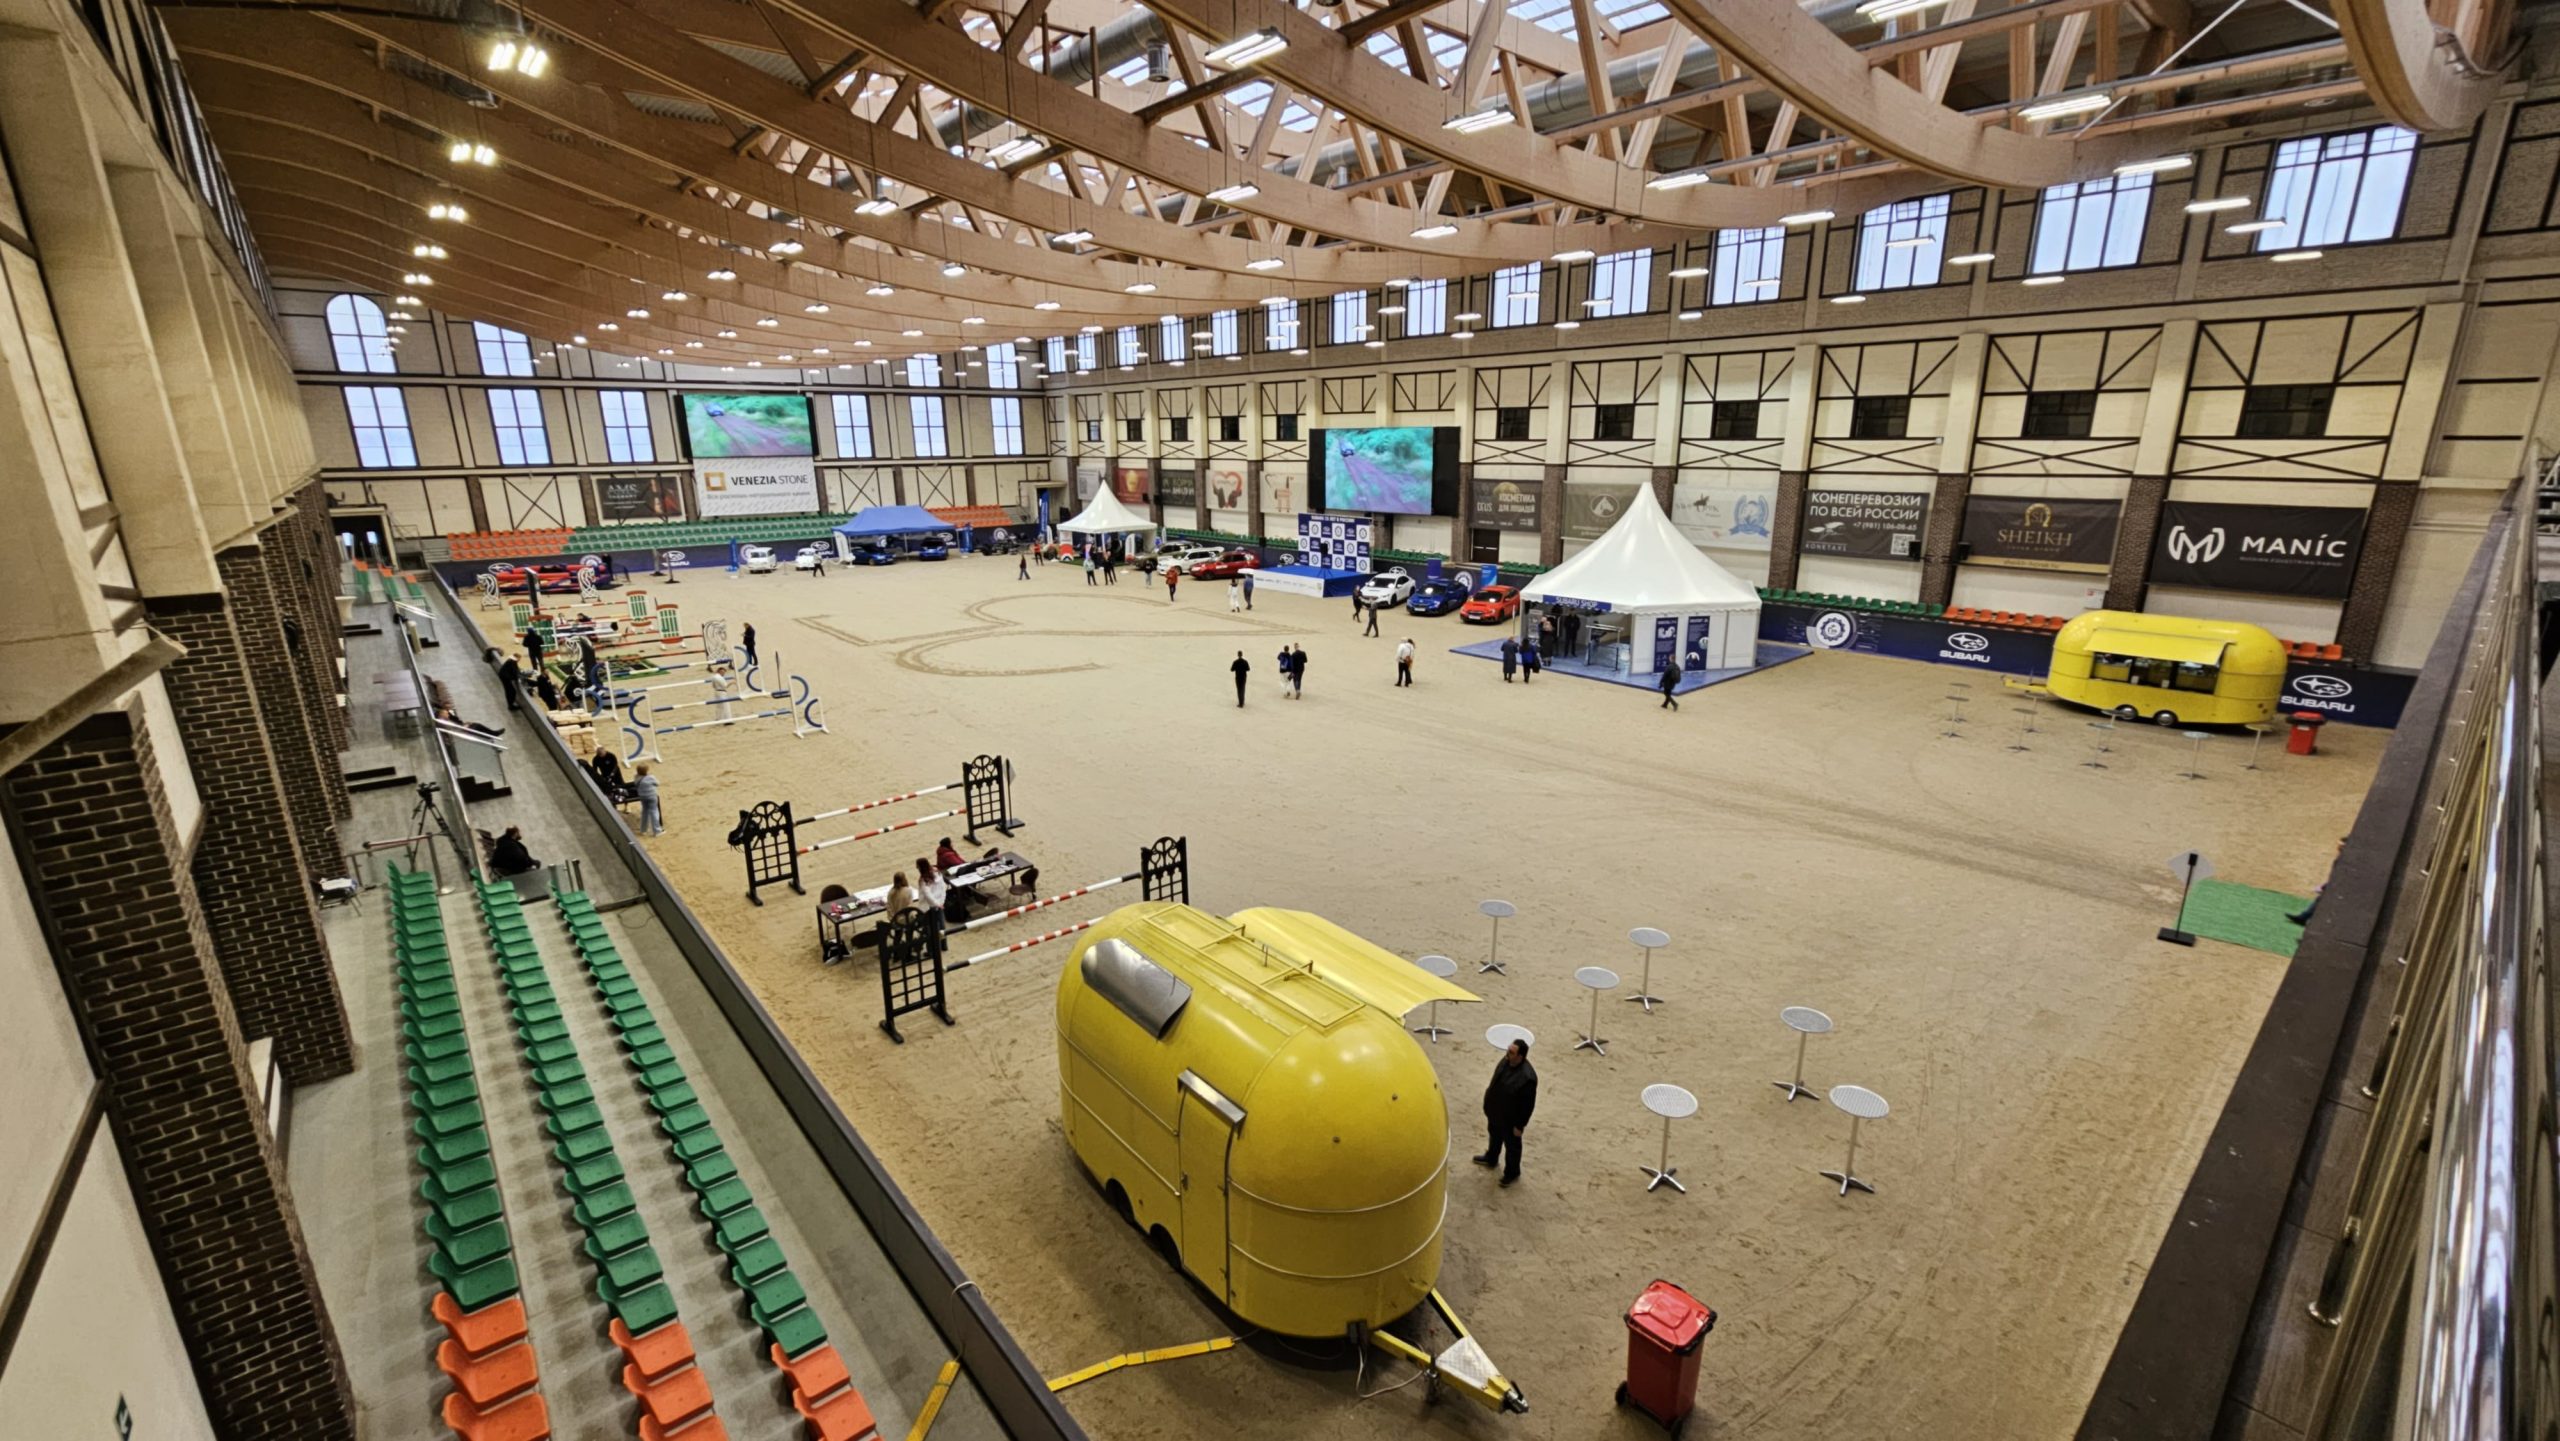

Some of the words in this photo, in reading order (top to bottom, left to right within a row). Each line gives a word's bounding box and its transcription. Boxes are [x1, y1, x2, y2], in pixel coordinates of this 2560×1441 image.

[731, 475, 777, 486] VENEZIA
[779, 474, 809, 485] STONE
[1811, 491, 1921, 506] КОНЕПЕРЕВОЗКИ
[1809, 505, 1829, 517] ПО
[1831, 505, 1862, 518] ВСЕЙ
[1864, 507, 1920, 521] РОССИИ
[1997, 528, 2072, 547] SHEIKH
[2241, 533, 2348, 558] MANÍC
[1555, 595, 1580, 608] SUBARU
[1581, 598, 1598, 609] SHOP
[1939, 649, 1990, 663] SUBARU
[2280, 694, 2356, 713] SUBARU
